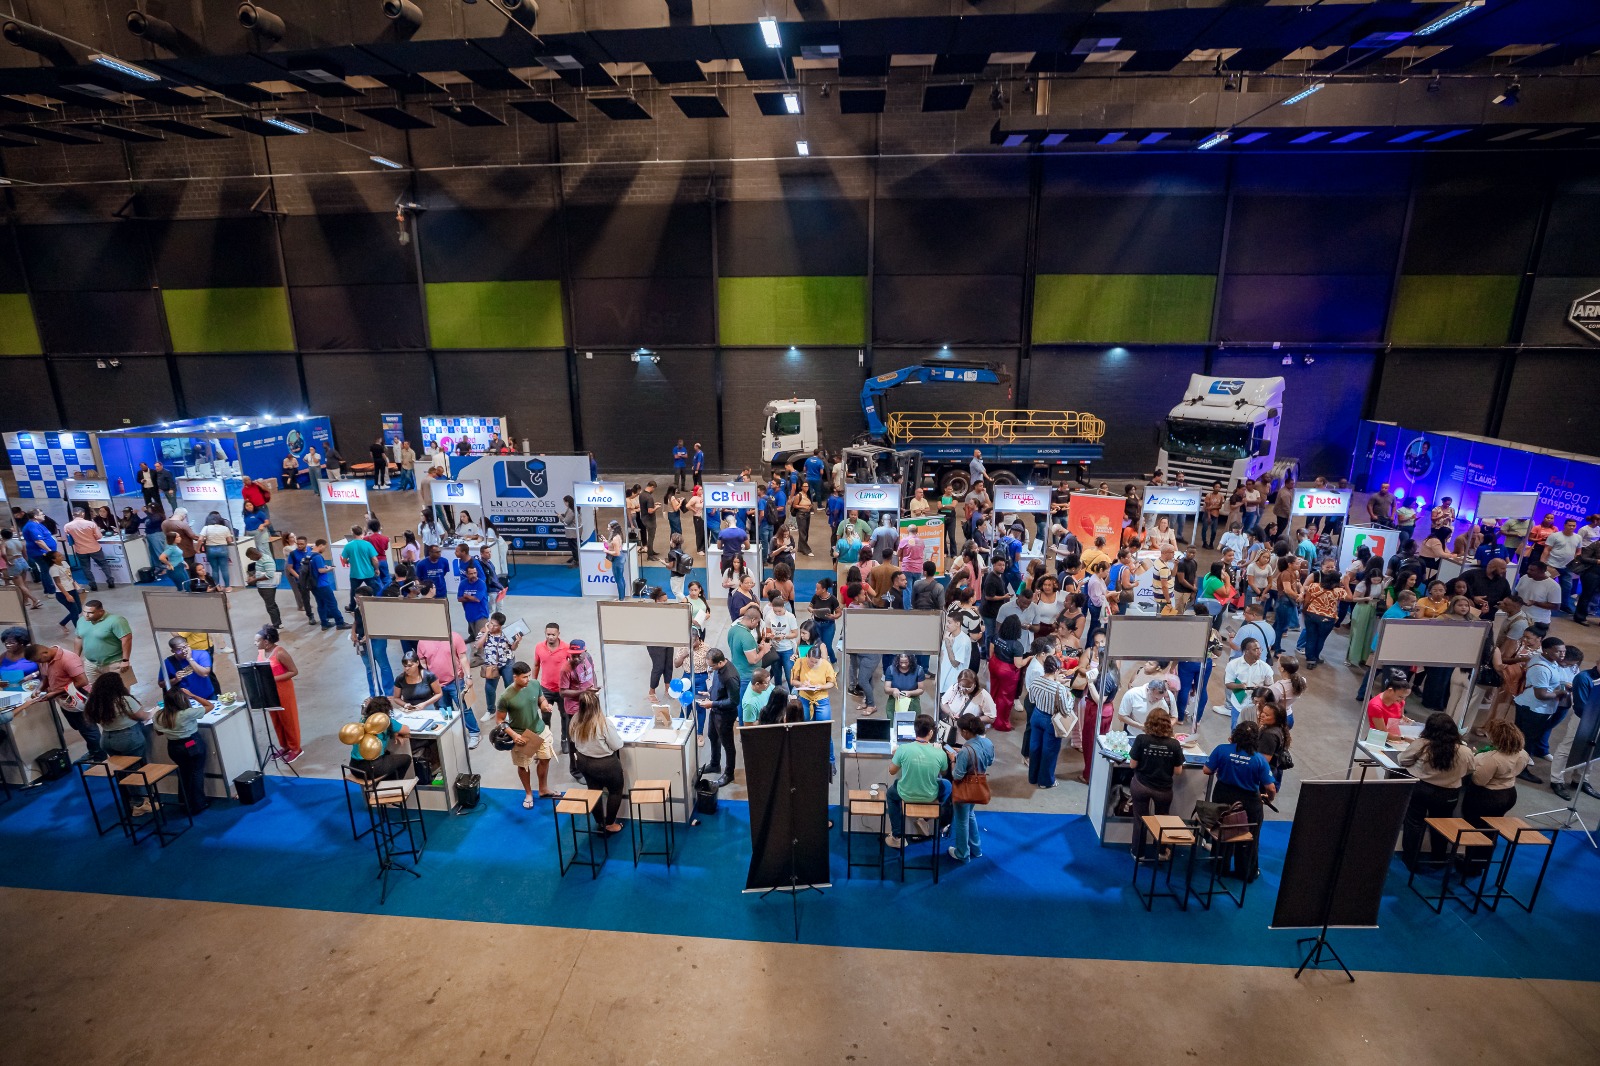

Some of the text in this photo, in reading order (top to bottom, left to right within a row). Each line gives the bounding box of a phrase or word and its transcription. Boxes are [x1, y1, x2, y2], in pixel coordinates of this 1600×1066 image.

[711, 491, 750, 502] CB full
[859, 491, 884, 500] Limiar
[1003, 492, 1034, 500] Ferreira
[1535, 482, 1591, 505] Emprega
[506, 499, 556, 509] LOCAÇÕES
[1159, 497, 1196, 507] Atakarejo
[1316, 496, 1342, 505] total
[587, 575, 616, 584] LARC
